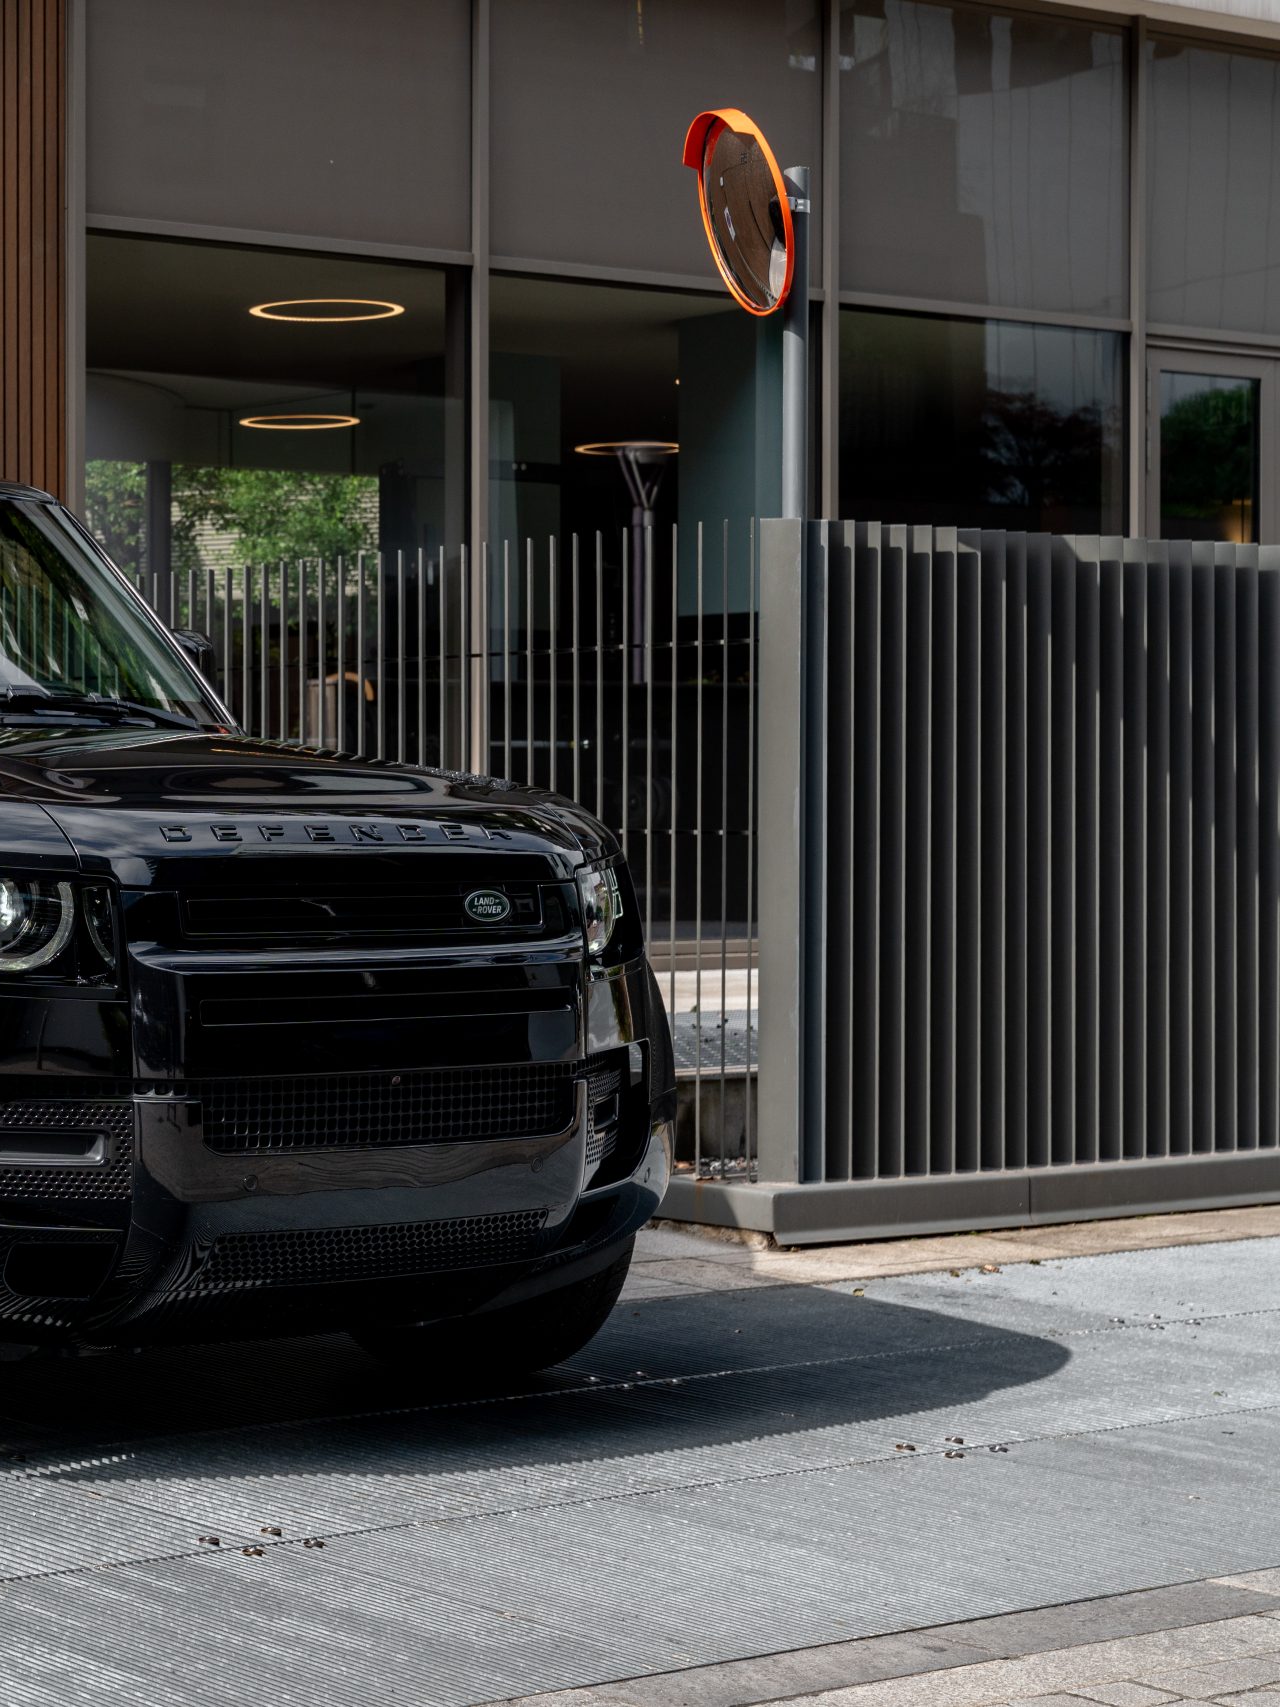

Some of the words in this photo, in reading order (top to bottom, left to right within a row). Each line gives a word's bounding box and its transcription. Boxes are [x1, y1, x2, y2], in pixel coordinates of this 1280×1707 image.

[159, 824, 512, 842] DEFENDER
[475, 897, 495, 906] LAND
[477, 906, 502, 914] ROVER
